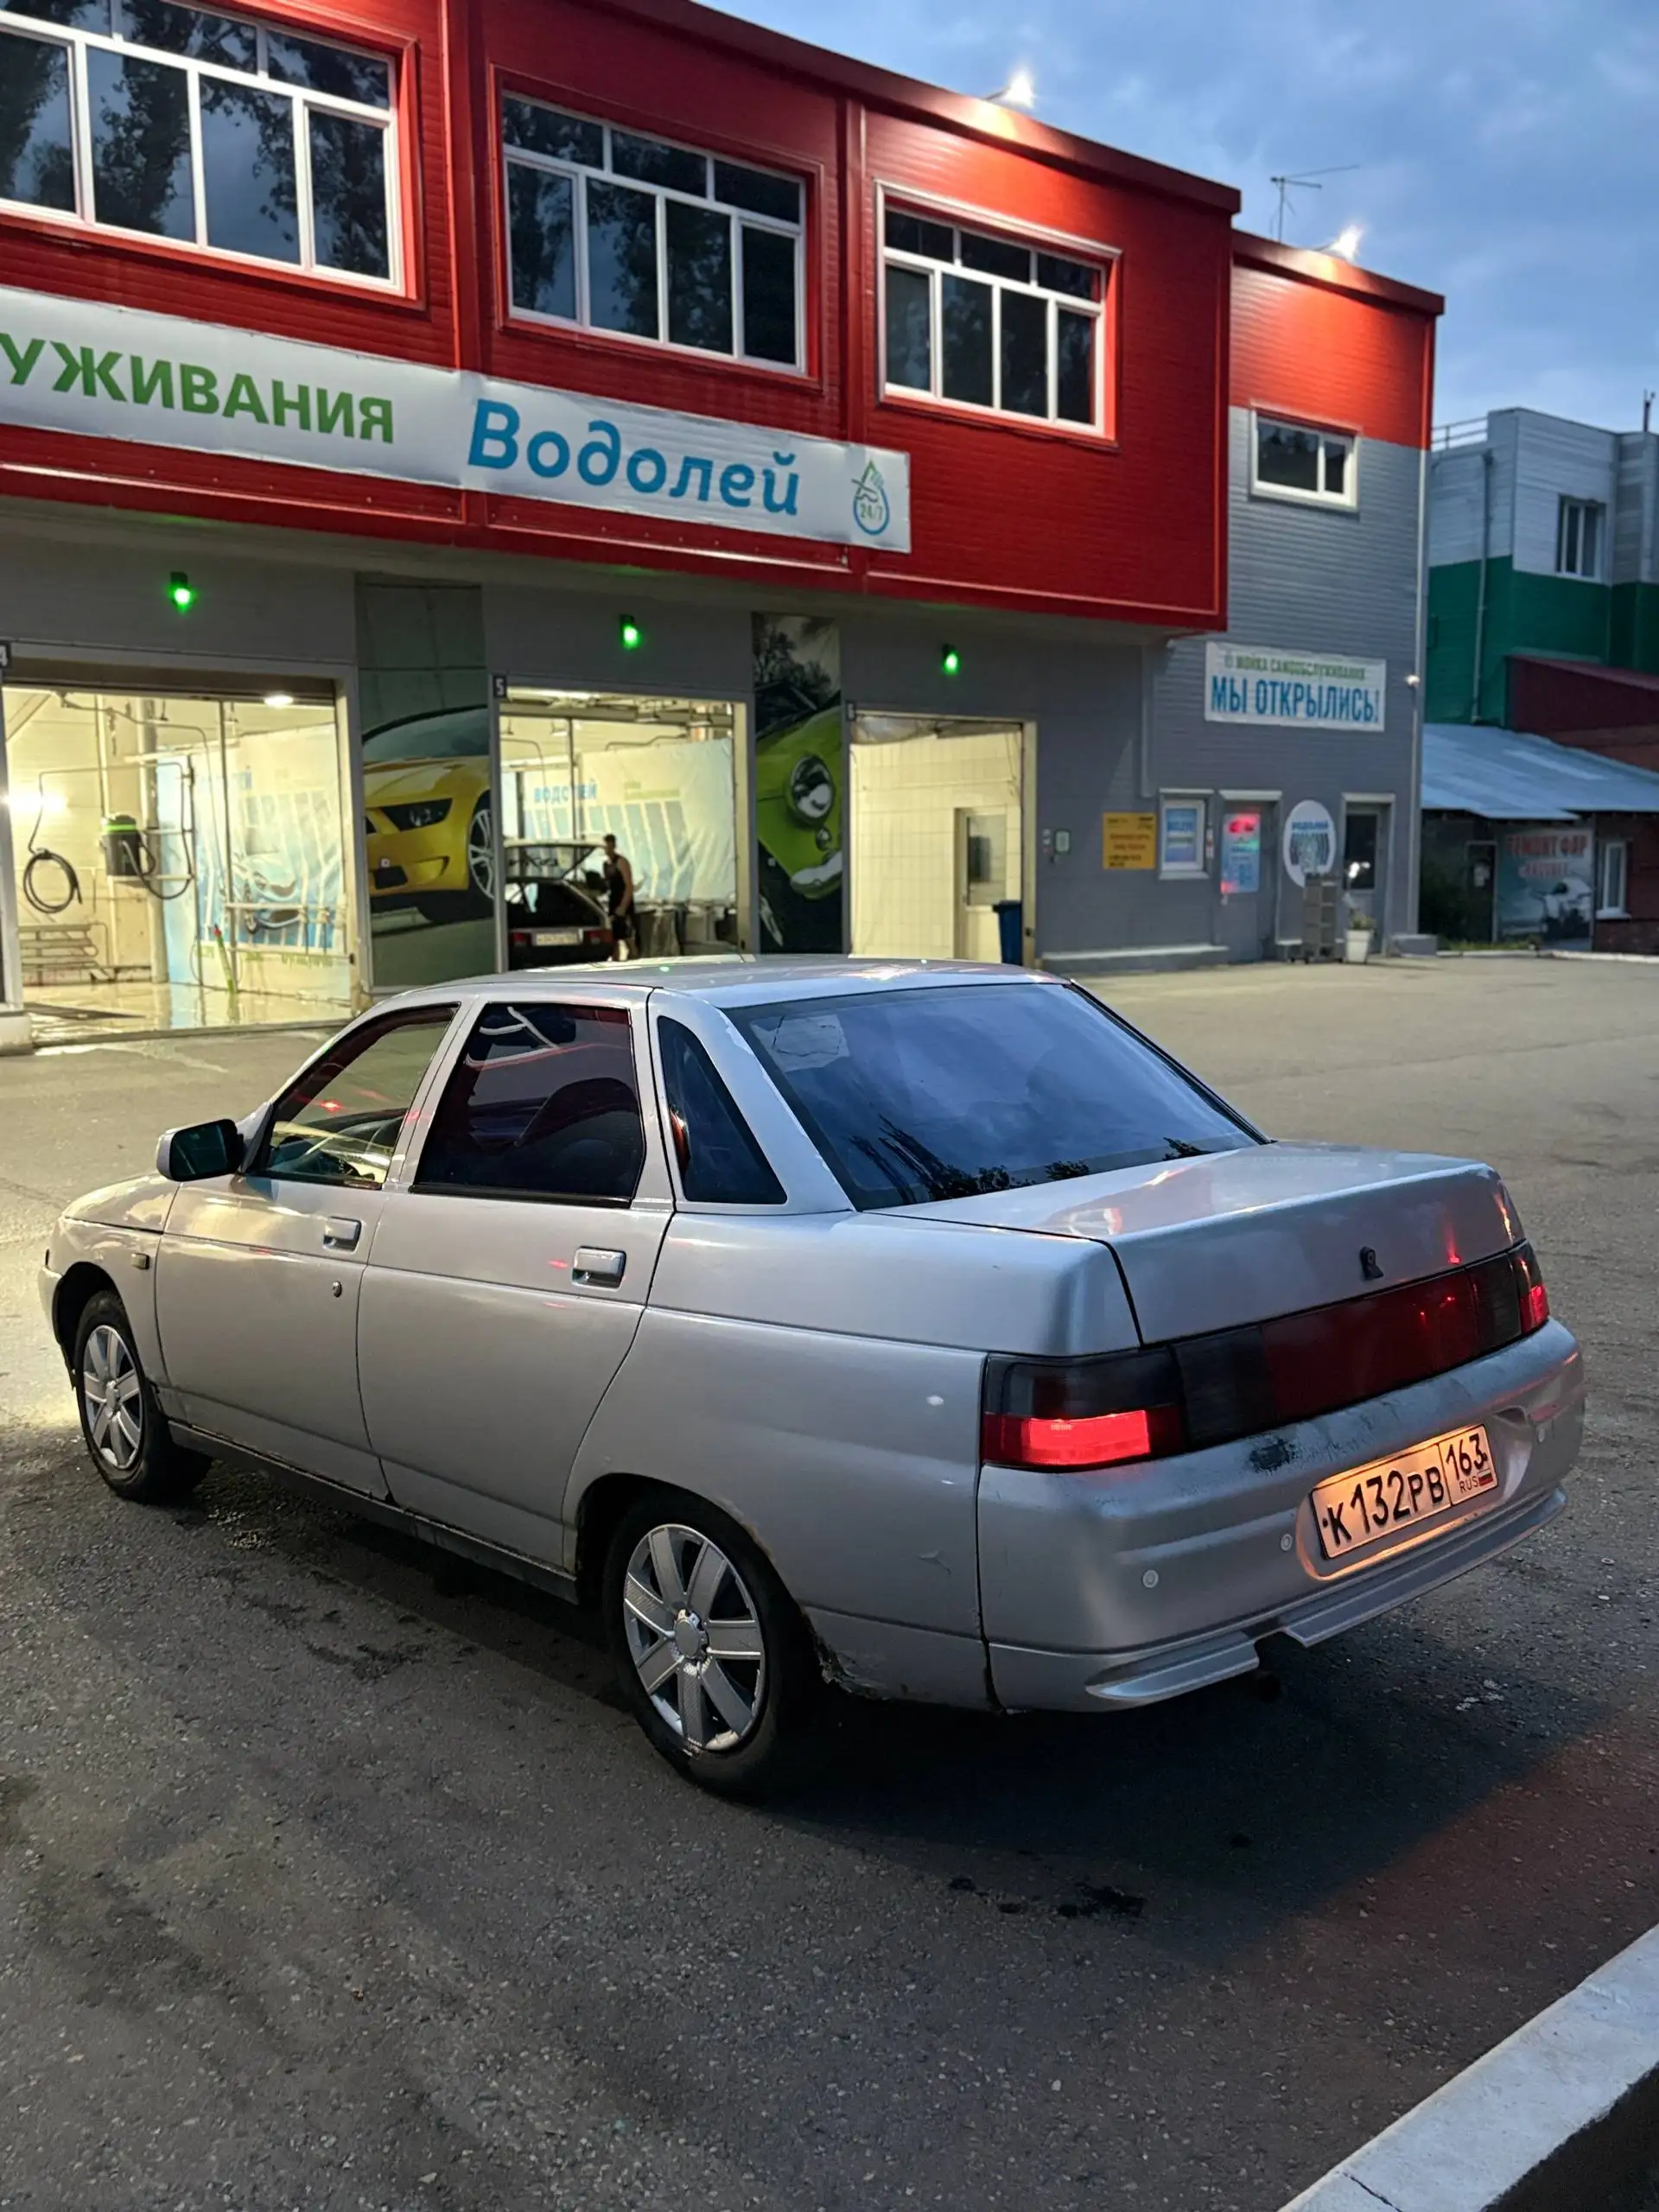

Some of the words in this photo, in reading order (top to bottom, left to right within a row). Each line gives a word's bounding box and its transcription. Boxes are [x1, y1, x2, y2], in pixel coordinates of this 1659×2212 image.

[0, 333, 394, 443] УЖИВАНИЯ
[467, 398, 799, 516] Водолей
[495, 678, 505, 696] 5
[1211, 676, 1248, 714] МЫ
[1255, 680, 1379, 723] ОТКРЫЛИСЬ!
[1446, 1433, 1486, 1481] 163
[1459, 1475, 1479, 1494] RUS
